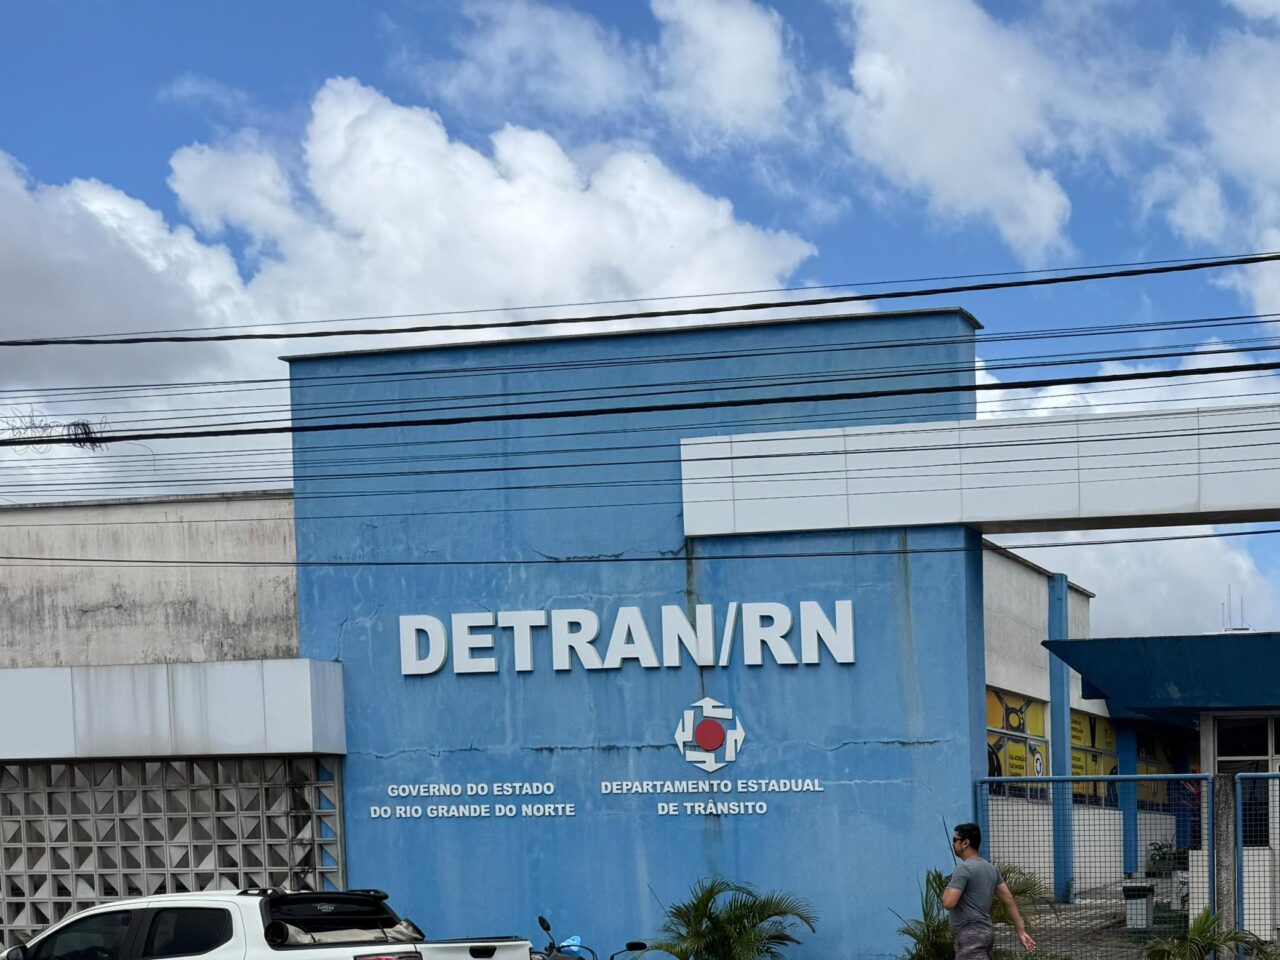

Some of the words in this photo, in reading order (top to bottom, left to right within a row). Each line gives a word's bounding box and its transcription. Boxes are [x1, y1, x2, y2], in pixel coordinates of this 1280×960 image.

[400, 600, 856, 676] DETRAN/RN
[387, 784, 463, 797] GOVERNO
[467, 783, 489, 796] DO
[493, 782, 555, 796] ESTADO
[601, 780, 732, 794] DEPARTAMENTO
[737, 779, 825, 792] ESTADUAL
[370, 805, 392, 818] DO
[395, 805, 423, 818] RIO
[427, 804, 491, 818] GRANDE
[495, 804, 517, 817] DO
[522, 803, 576, 817] NORTE
[658, 802, 679, 815] DE
[684, 799, 768, 815] TRÂNSITO
